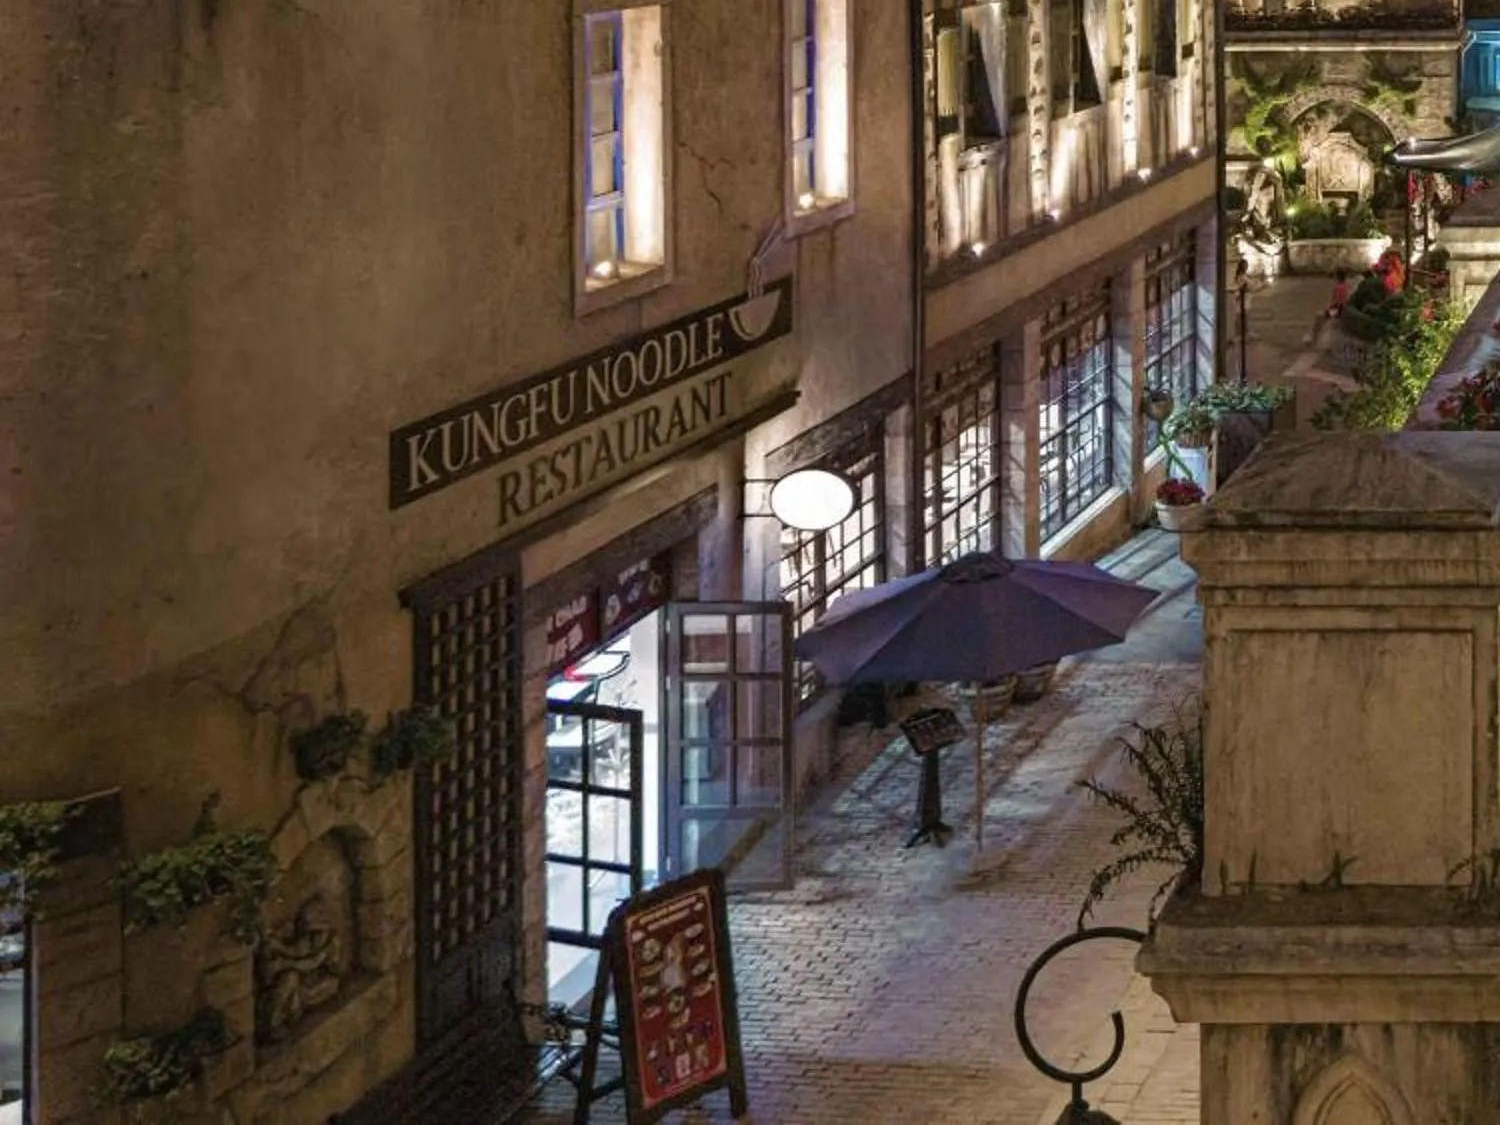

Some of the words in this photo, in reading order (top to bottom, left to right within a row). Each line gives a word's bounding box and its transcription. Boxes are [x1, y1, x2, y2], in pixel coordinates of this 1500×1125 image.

[406, 371, 578, 492] KUNGFU
[583, 313, 724, 413] NOODLE
[495, 371, 733, 527] RESTAURANT
